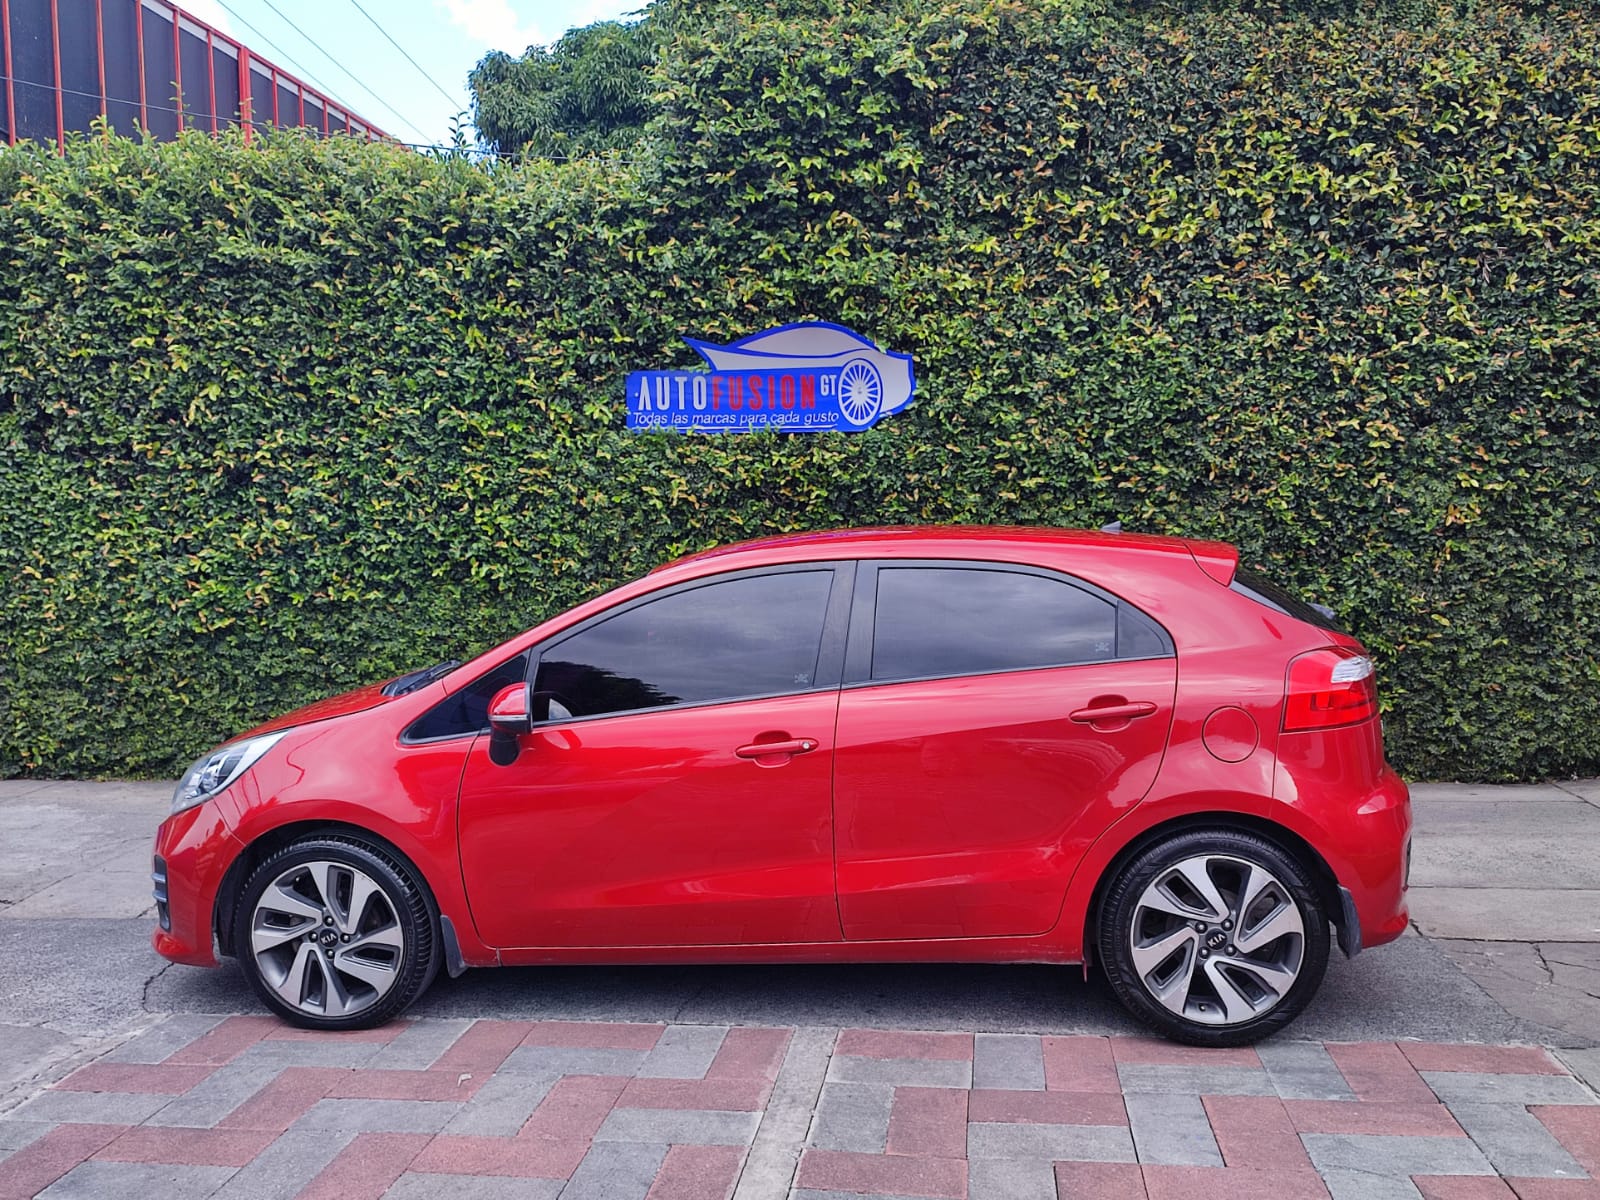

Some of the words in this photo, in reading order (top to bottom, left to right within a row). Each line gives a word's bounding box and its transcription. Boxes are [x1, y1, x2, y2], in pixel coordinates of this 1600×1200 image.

[820, 374, 838, 396] GT
[633, 411, 668, 425] Todas
[671, 411, 689, 425] las
[692, 413, 737, 424] marcas
[740, 413, 768, 426] para
[770, 410, 800, 424] cada
[804, 410, 840, 426] gusto
[320, 933, 337, 944] KIA
[1207, 933, 1226, 947] KIA
